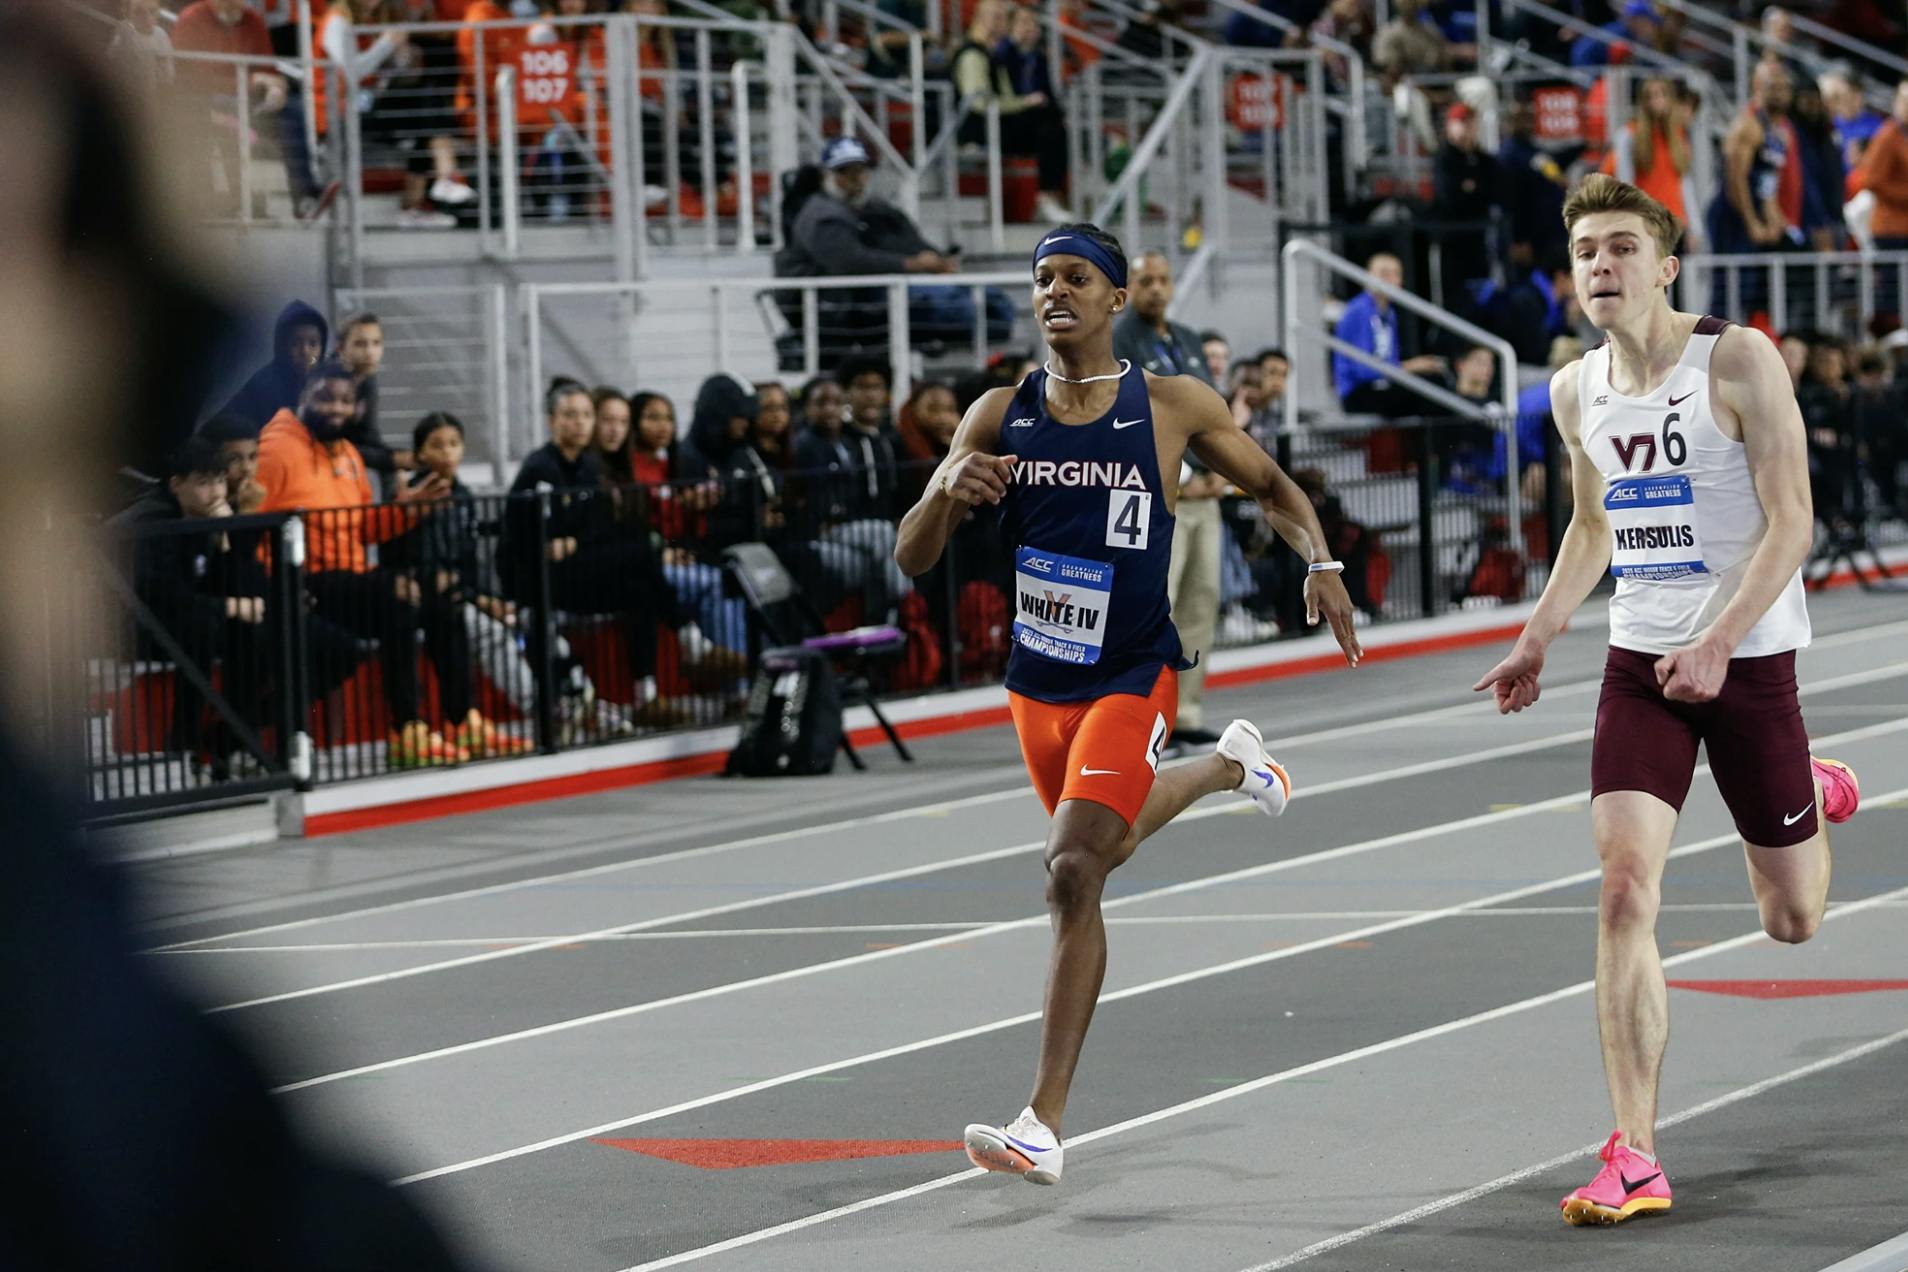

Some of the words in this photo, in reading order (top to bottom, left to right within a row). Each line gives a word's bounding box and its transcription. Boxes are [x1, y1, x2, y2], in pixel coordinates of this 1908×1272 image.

[521, 50, 569, 76] 106
[522, 78, 569, 104] 107
[1010, 418, 1036, 427] ACC
[1662, 412, 1687, 466] 6
[1010, 461, 1147, 490] VIRGINIA
[1609, 488, 1638, 501] ACC
[1644, 488, 1681, 499] GREATNESS
[1113, 494, 1142, 545] 4
[1615, 525, 1694, 550] KERSULIS
[1023, 556, 1055, 573] ACC
[1061, 568, 1102, 582] GREATNESS
[1020, 591, 1075, 625] WHITE
[1077, 606, 1099, 630] IV
[1020, 633, 1086, 663] CHAMPIONSHIPS
